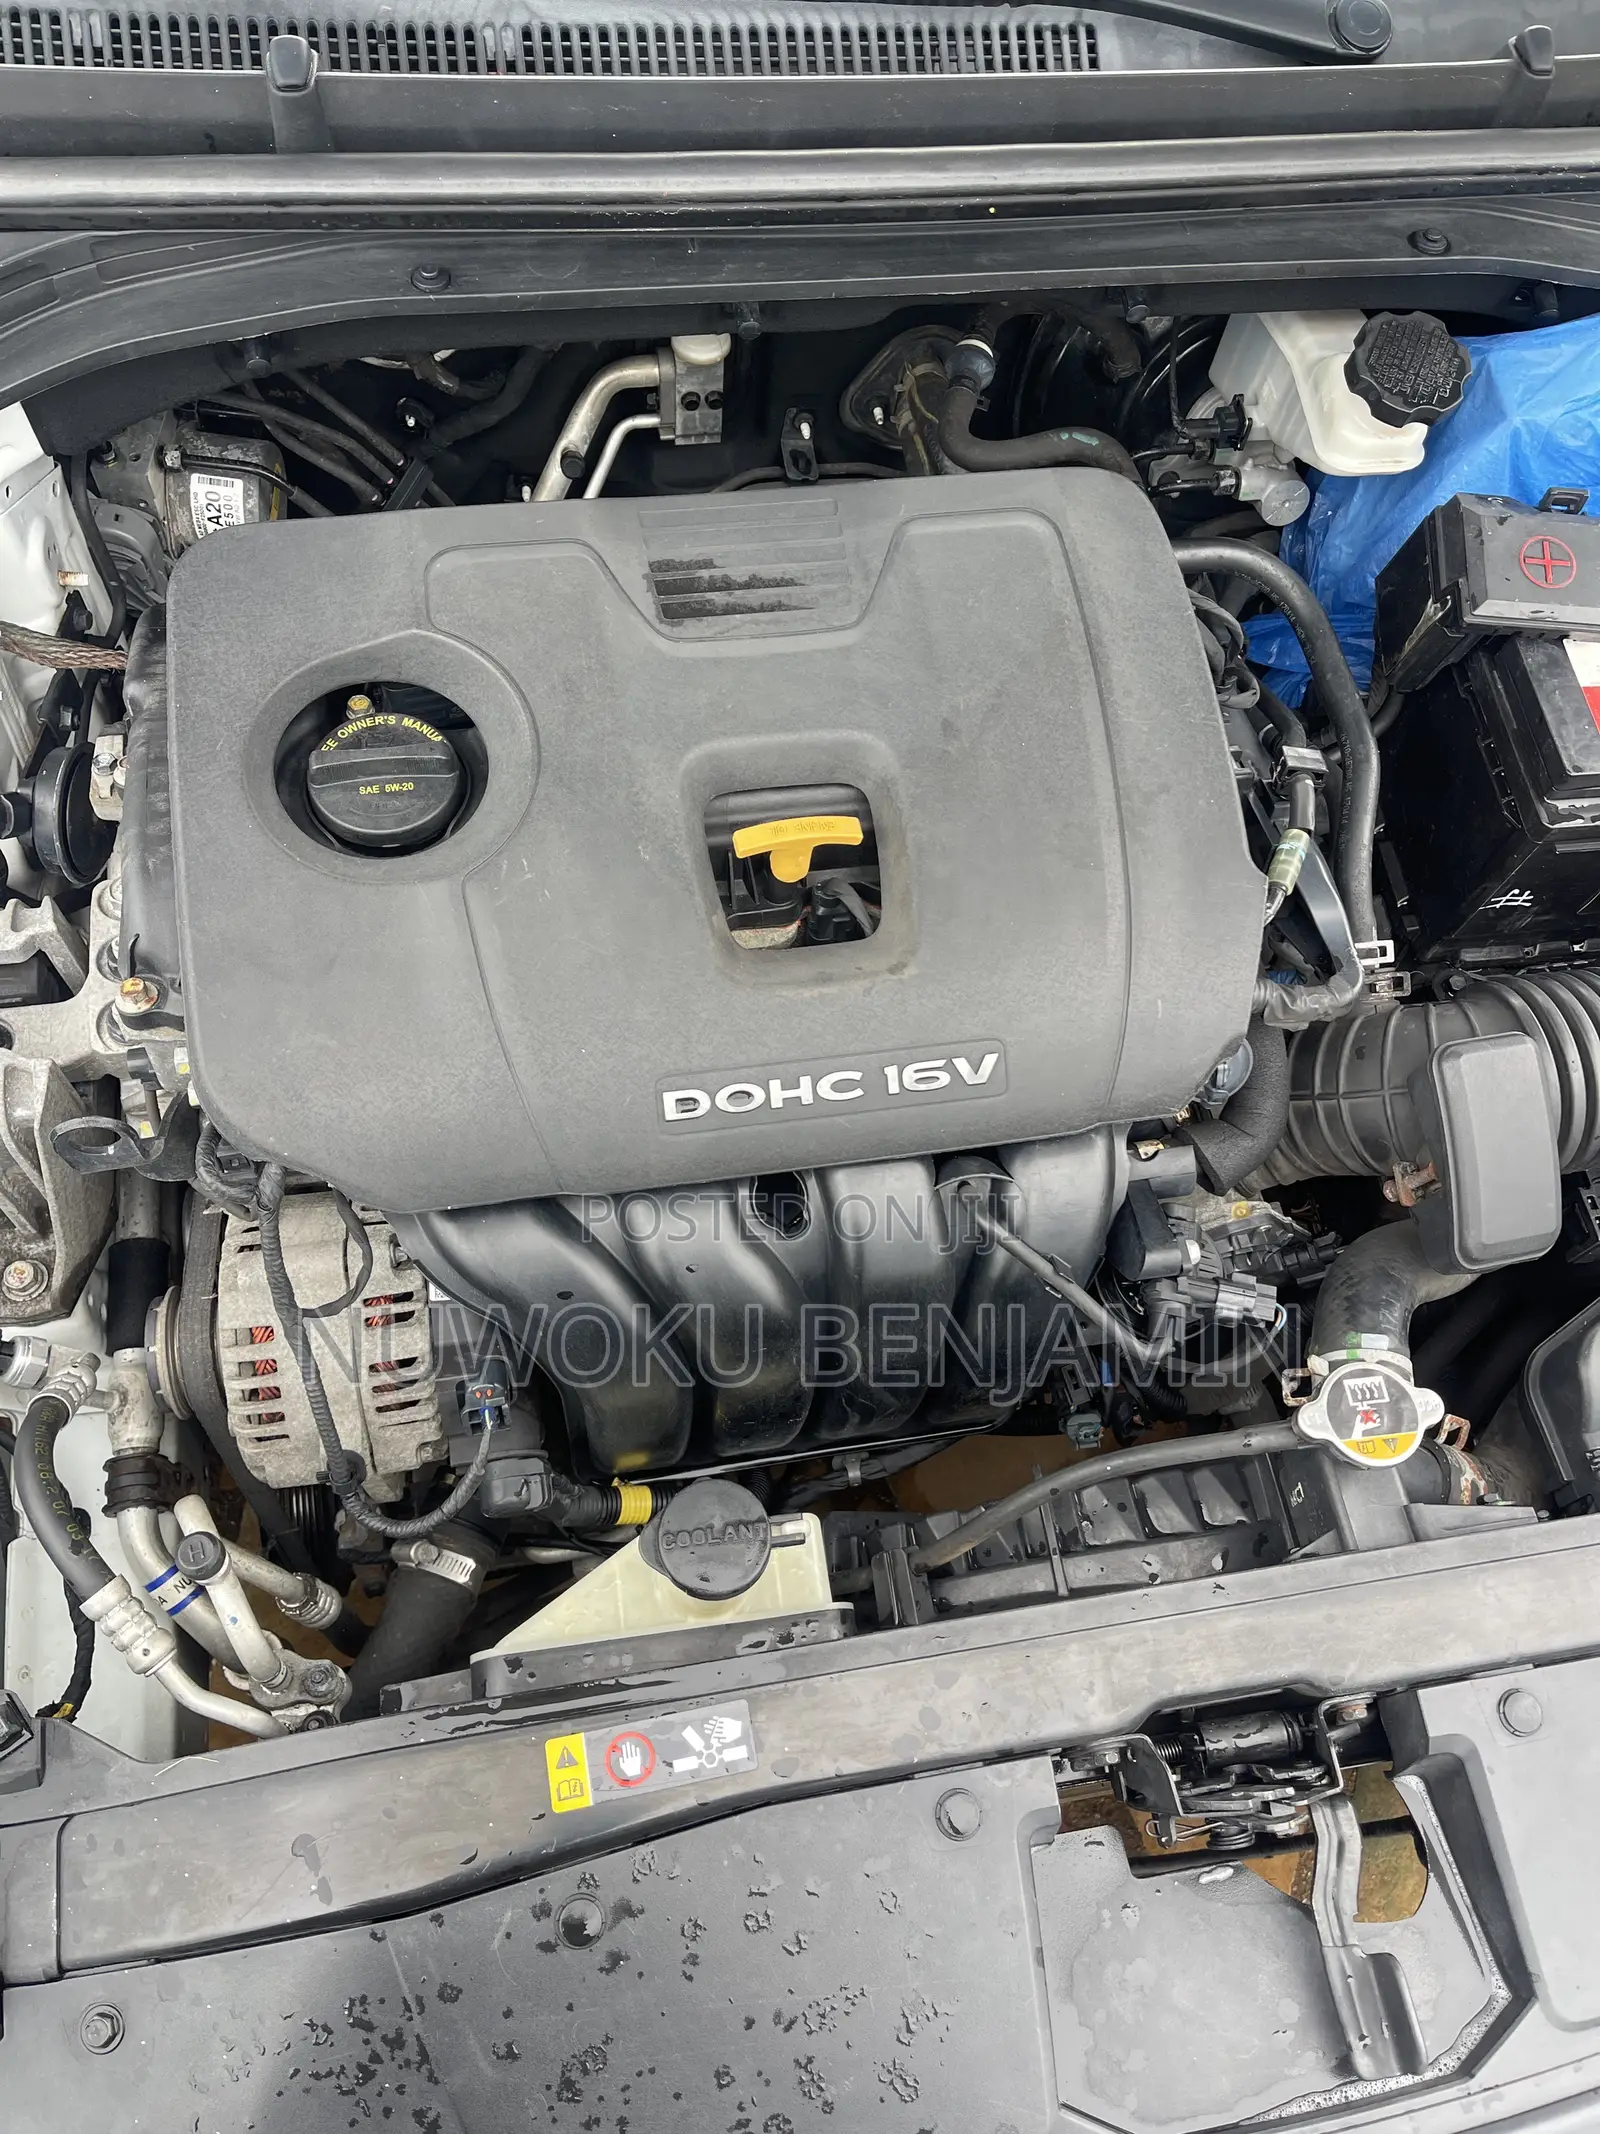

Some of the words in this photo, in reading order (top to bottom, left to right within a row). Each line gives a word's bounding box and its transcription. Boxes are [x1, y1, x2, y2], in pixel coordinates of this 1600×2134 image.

[205, 491, 224, 527] A20
[321, 738, 339, 752] EE
[337, 715, 396, 739] OWNER'S
[401, 717, 447, 743] MANUA
[359, 785, 380, 795] SAE
[384, 782, 414, 793] 5W-20
[662, 1070, 865, 1122] DOHC
[883, 1052, 999, 1095] 16V
[662, 1521, 768, 1550] COOLANT
[188, 1541, 206, 1563] H
